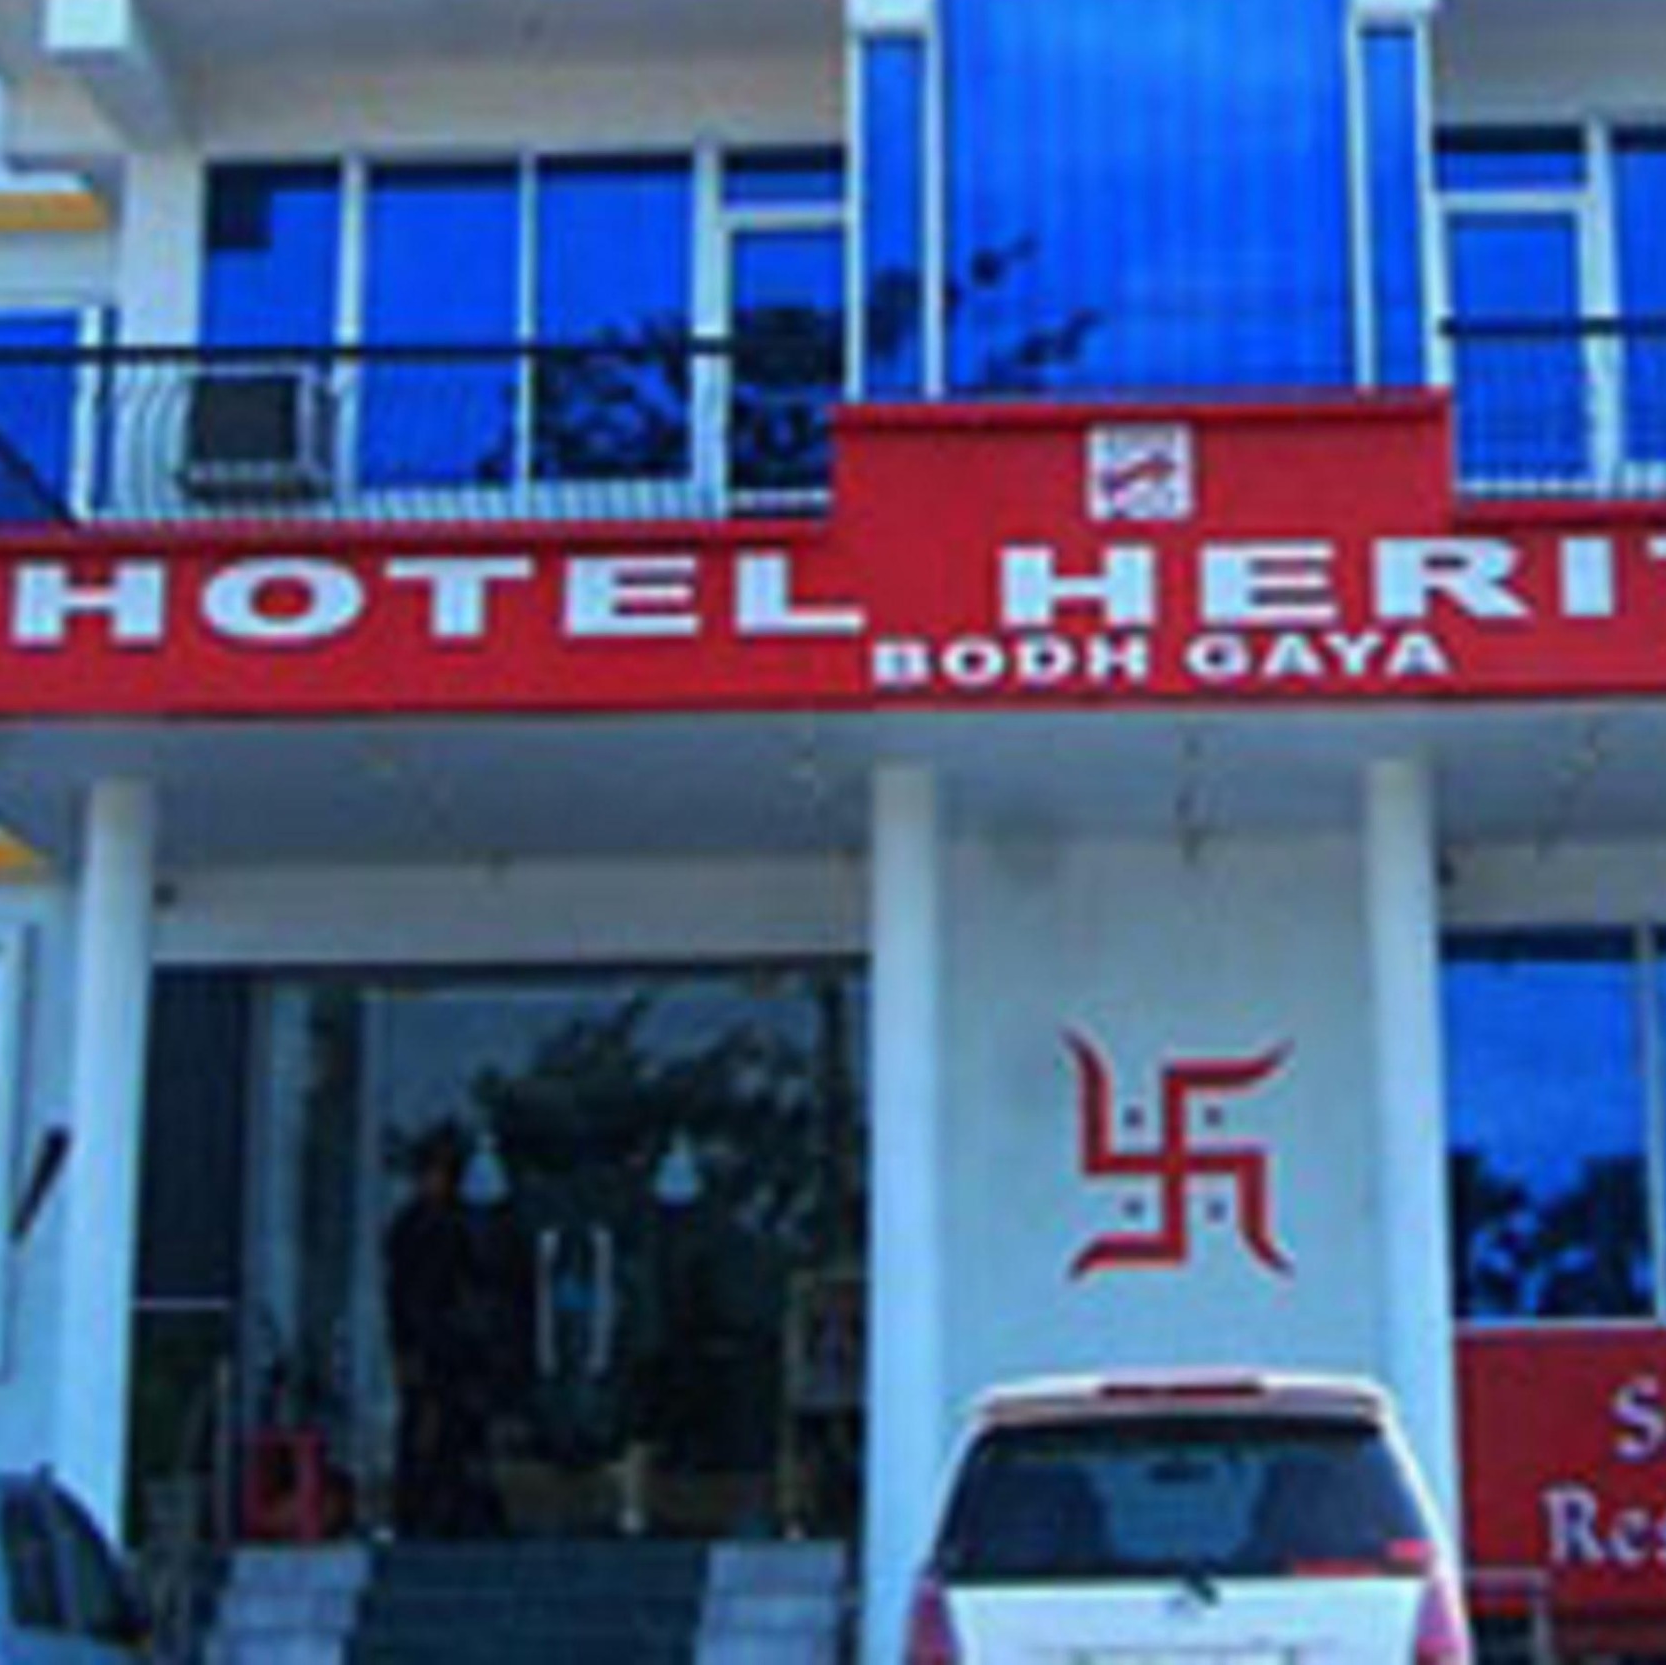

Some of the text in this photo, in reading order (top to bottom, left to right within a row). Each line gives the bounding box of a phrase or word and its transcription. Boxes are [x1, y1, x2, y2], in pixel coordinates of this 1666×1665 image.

[9, 549, 868, 646] HOTEL
[870, 631, 1451, 687] BODH GAYA
